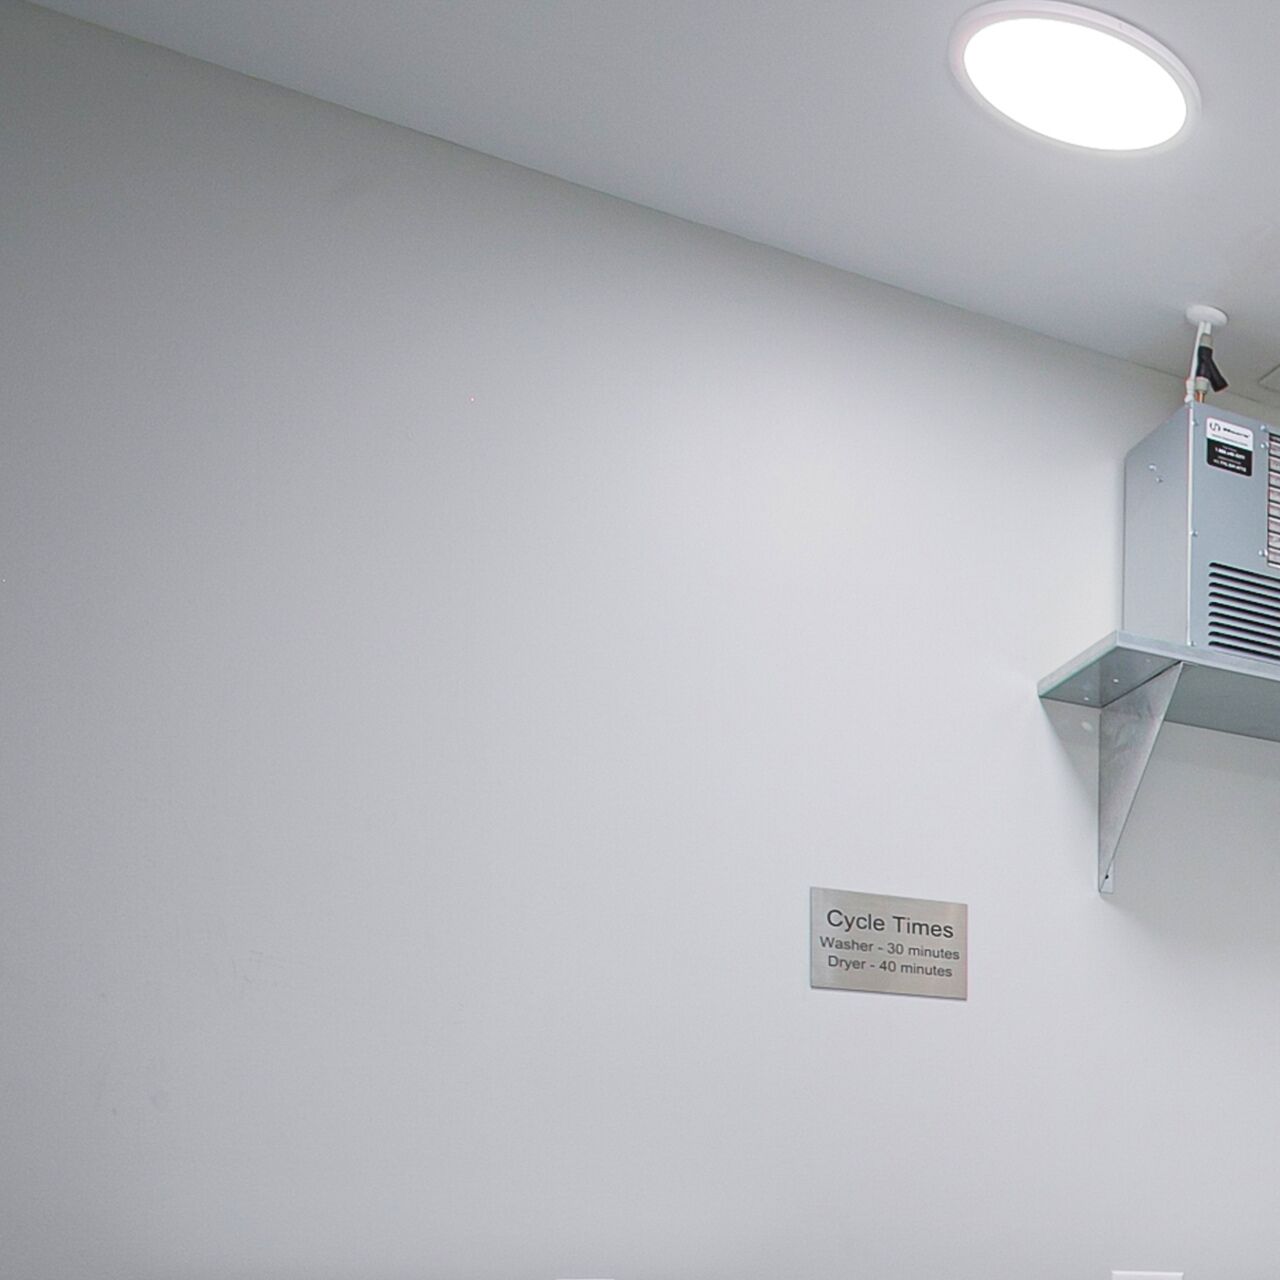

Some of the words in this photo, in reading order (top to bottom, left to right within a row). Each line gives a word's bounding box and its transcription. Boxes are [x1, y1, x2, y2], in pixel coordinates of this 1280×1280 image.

[826, 908, 886, 933] Cycle
[892, 915, 955, 939] Times
[819, 935, 875, 953] Washer
[886, 942, 904, 956] 30
[907, 945, 961, 961] minutes
[827, 955, 867, 972] Dryer
[878, 960, 897, 973] 40
[900, 963, 953, 978] minutes
